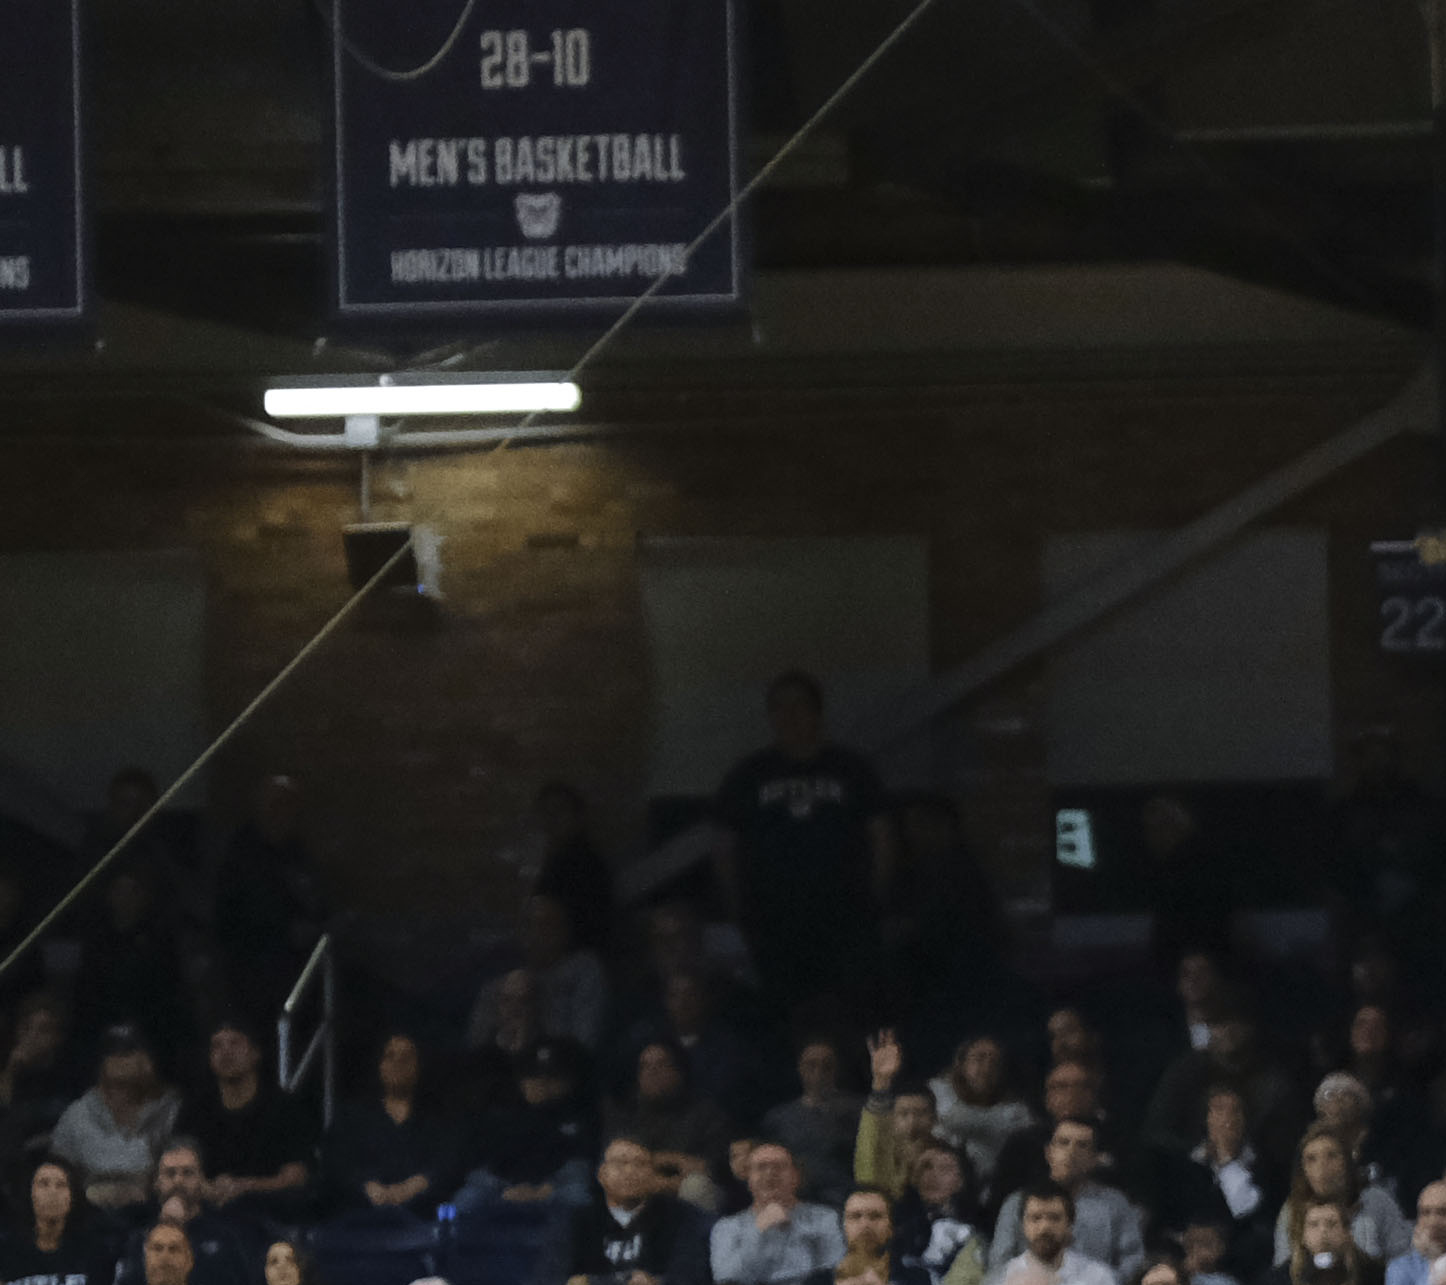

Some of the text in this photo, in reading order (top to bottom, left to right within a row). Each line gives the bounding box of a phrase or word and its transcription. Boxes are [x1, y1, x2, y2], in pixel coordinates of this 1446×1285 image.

[480, 27, 591, 90] 28-10
[389, 133, 686, 188] MEN'S BASKETBALL
[390, 243, 688, 283] HORIZON LEAGUE CHAMPIONS
